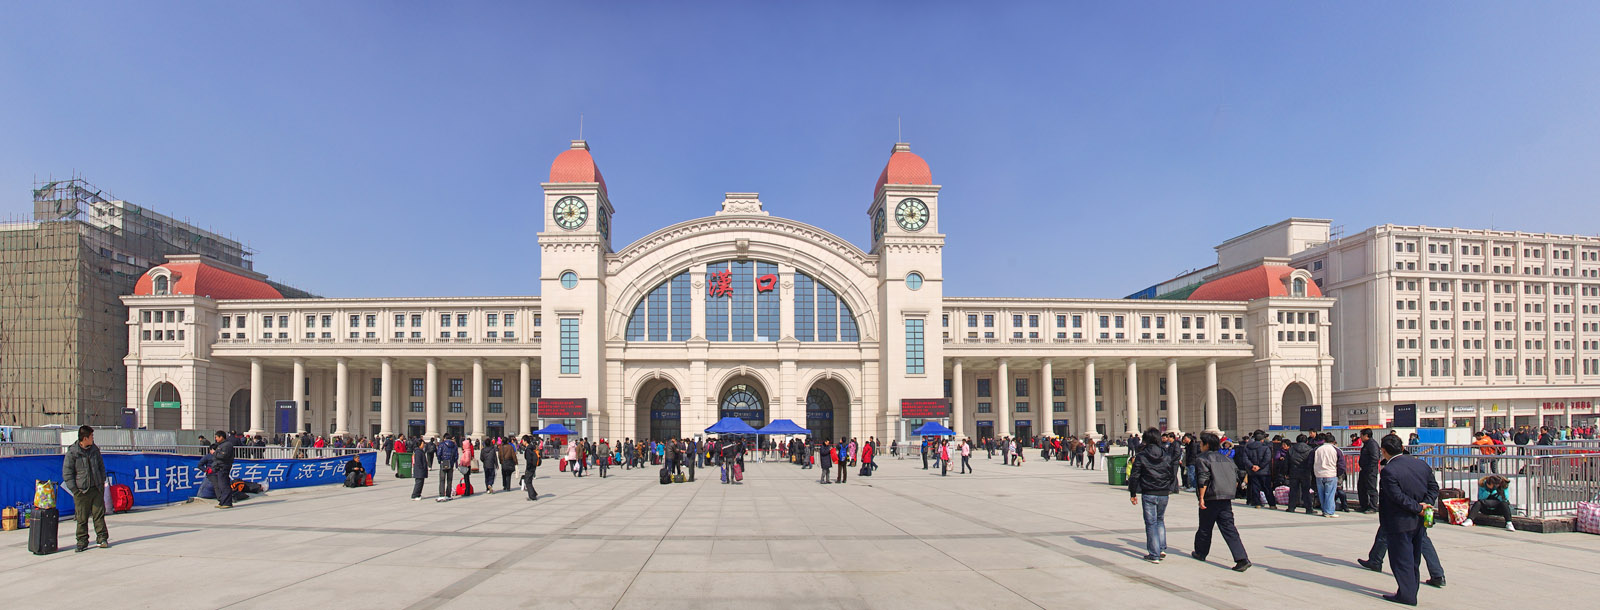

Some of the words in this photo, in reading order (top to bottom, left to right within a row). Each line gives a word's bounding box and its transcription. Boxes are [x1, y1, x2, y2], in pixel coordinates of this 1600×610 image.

[708, 269, 777, 297] 漢口
[295, 459, 346, 480] 洗手间
